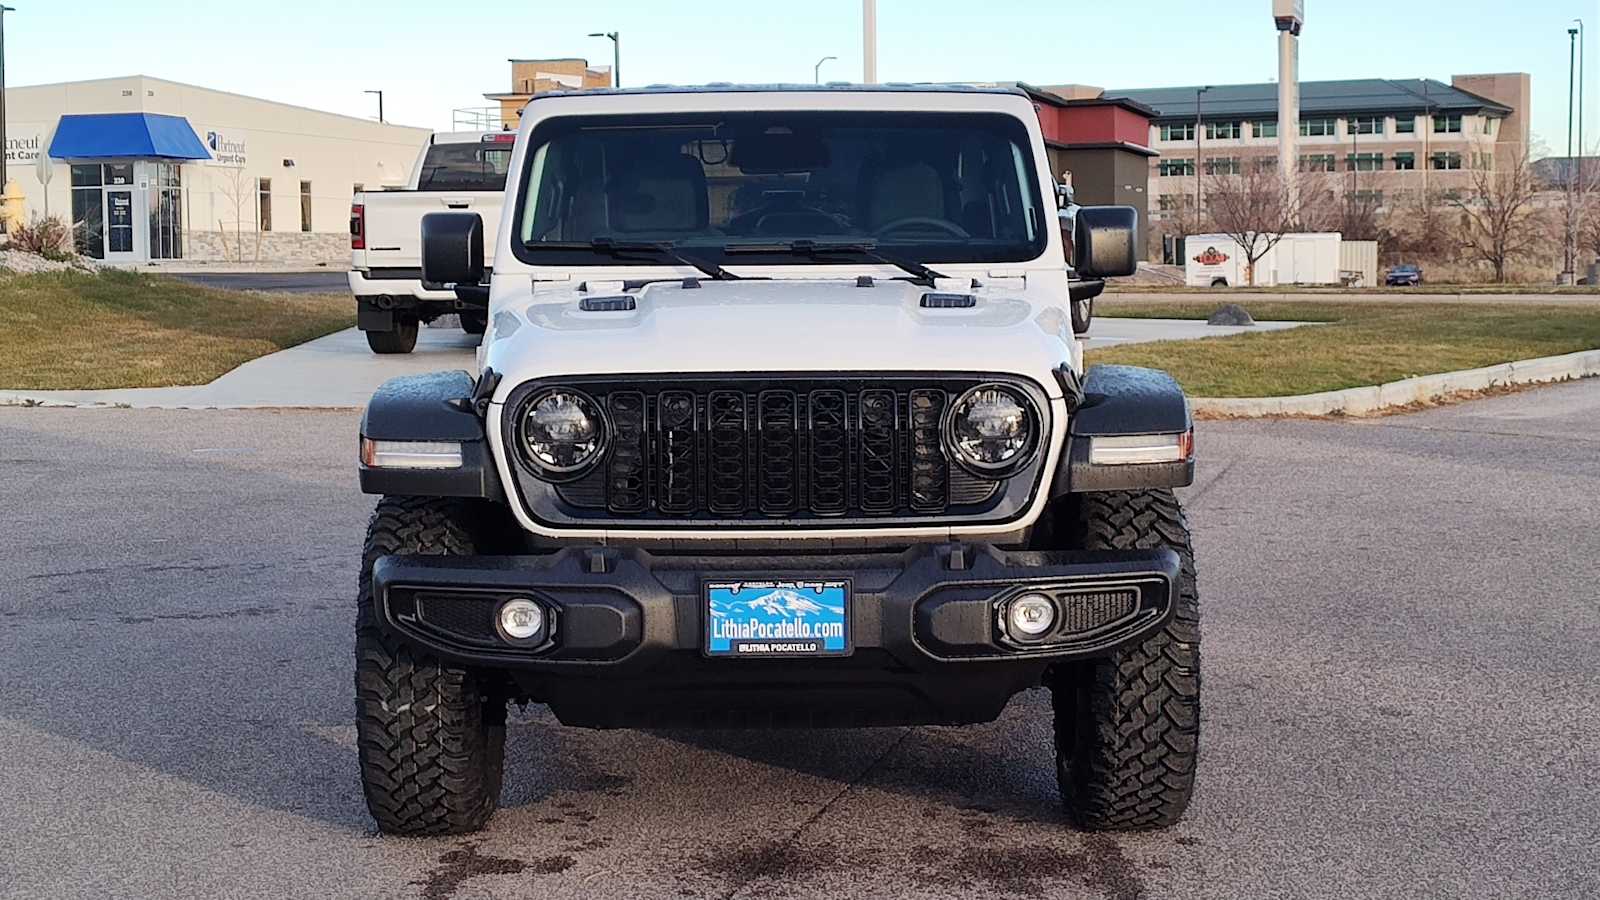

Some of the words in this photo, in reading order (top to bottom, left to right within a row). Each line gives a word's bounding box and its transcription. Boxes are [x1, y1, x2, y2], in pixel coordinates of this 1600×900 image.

[217, 134, 246, 153] Portneuf
[18, 151, 40, 160] Care
[713, 618, 843, 639] LithiaPocatello.com
[770, 643, 817, 652] POCATELLO
